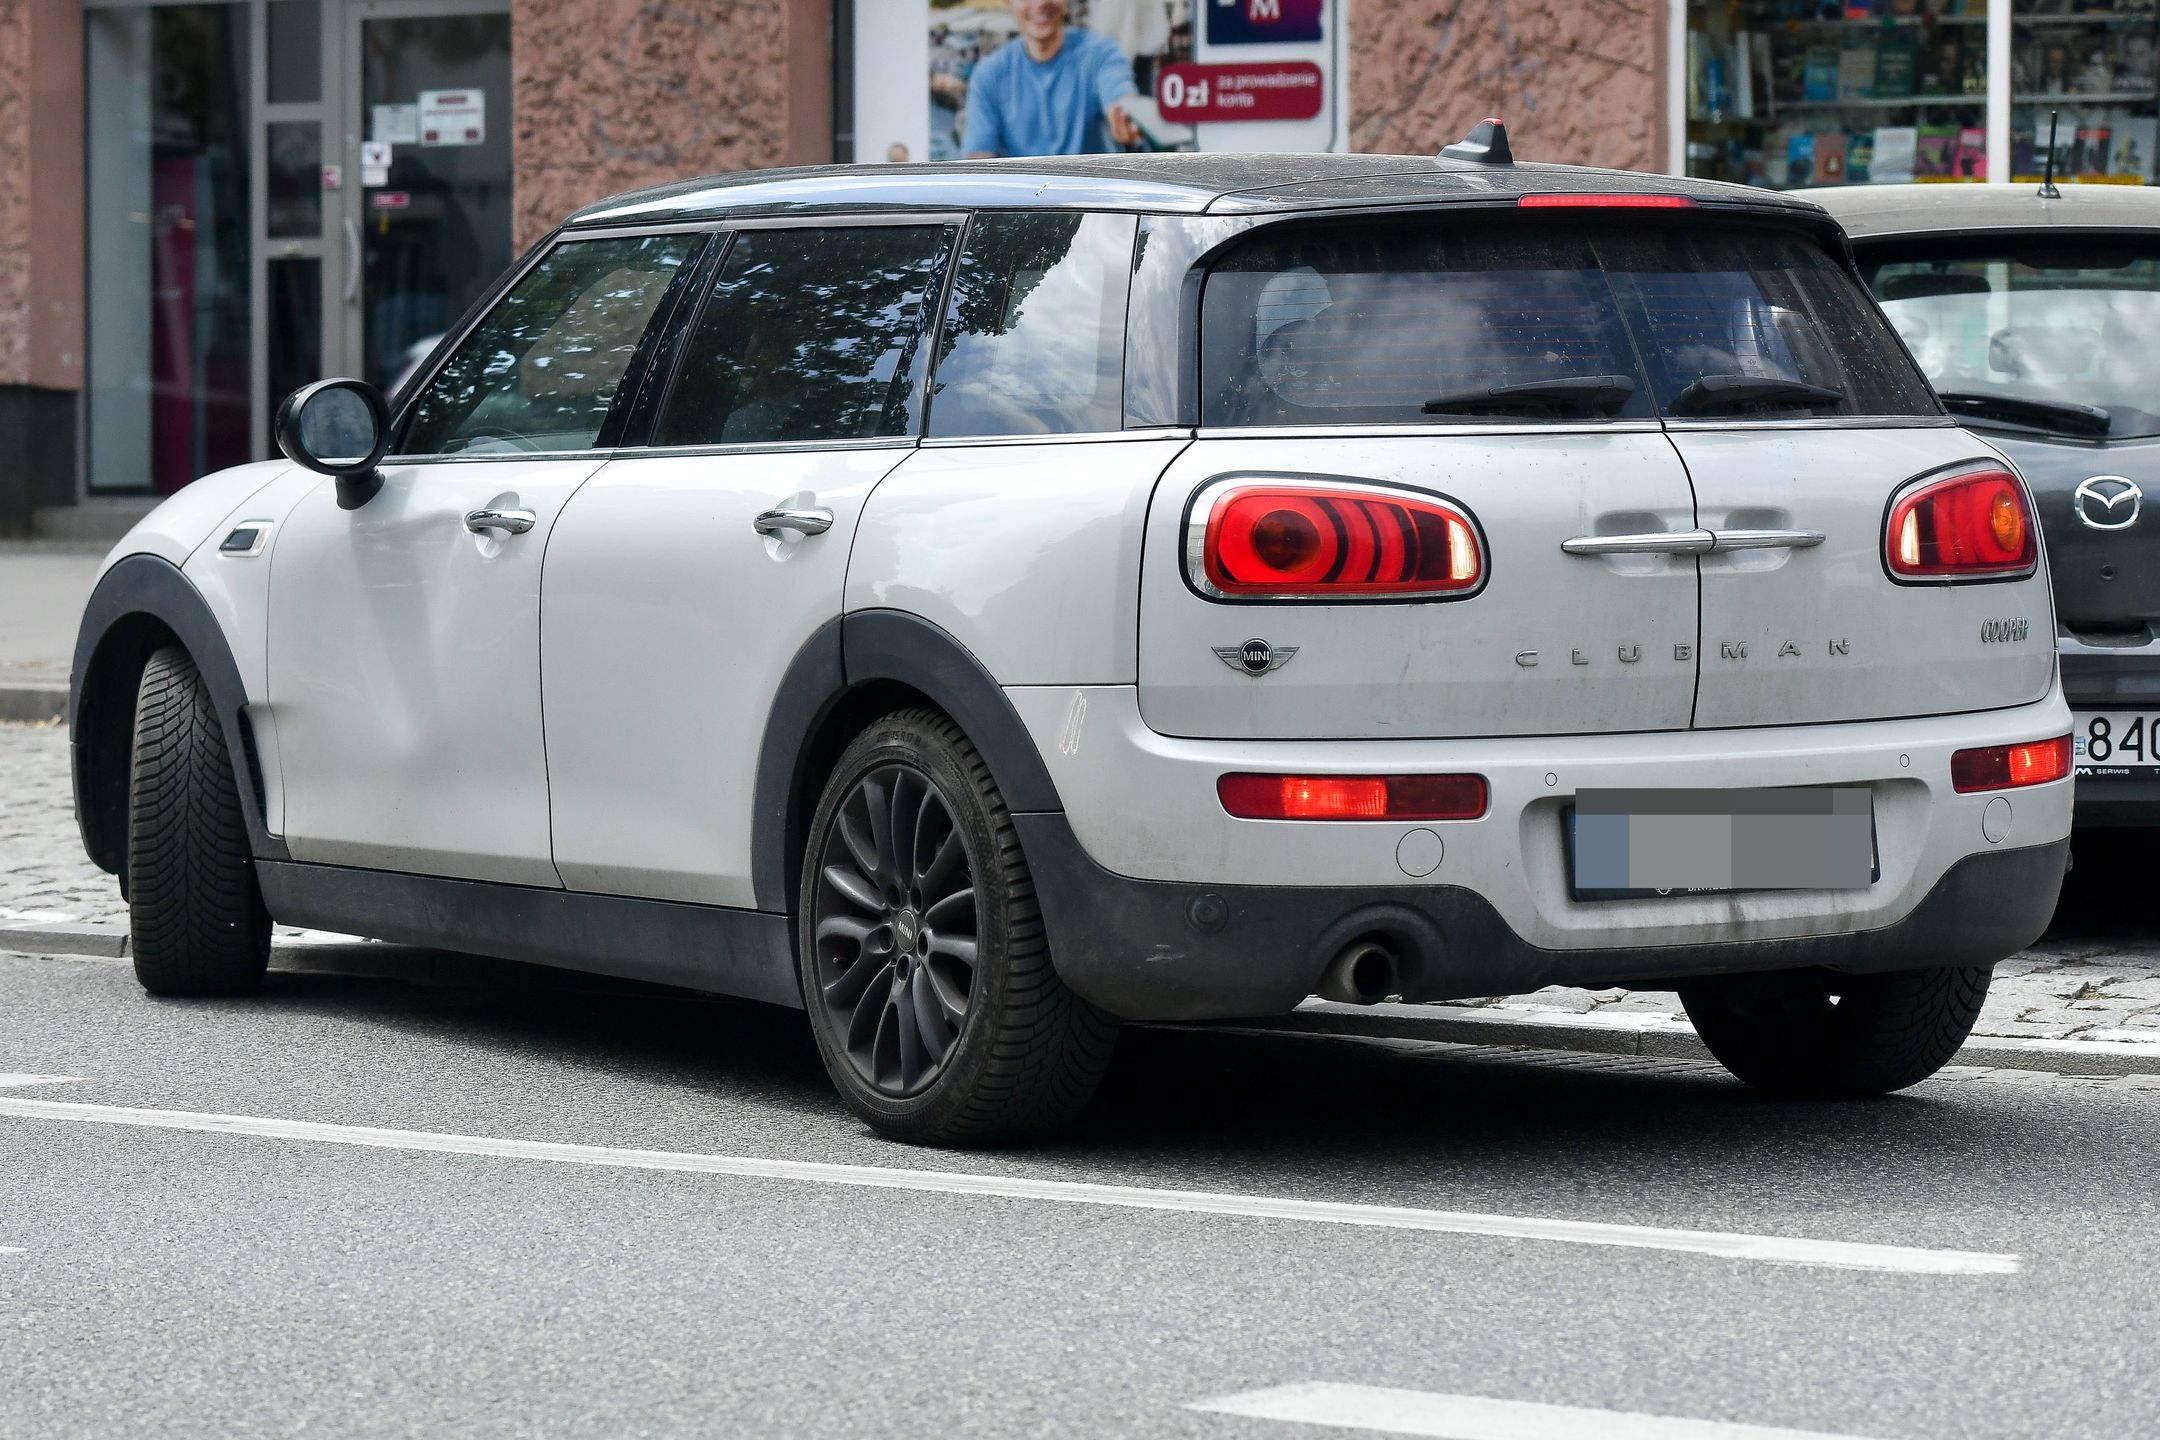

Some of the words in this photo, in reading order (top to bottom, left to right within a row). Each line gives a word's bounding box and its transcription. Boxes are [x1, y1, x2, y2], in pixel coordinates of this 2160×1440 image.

[1161, 74, 1185, 108] 0
[1186, 79, 1209, 108] zł
[1243, 651, 1270, 661] MINI
[1515, 639, 1850, 667] CLUBMAN
[898, 920, 913, 940] MINI
